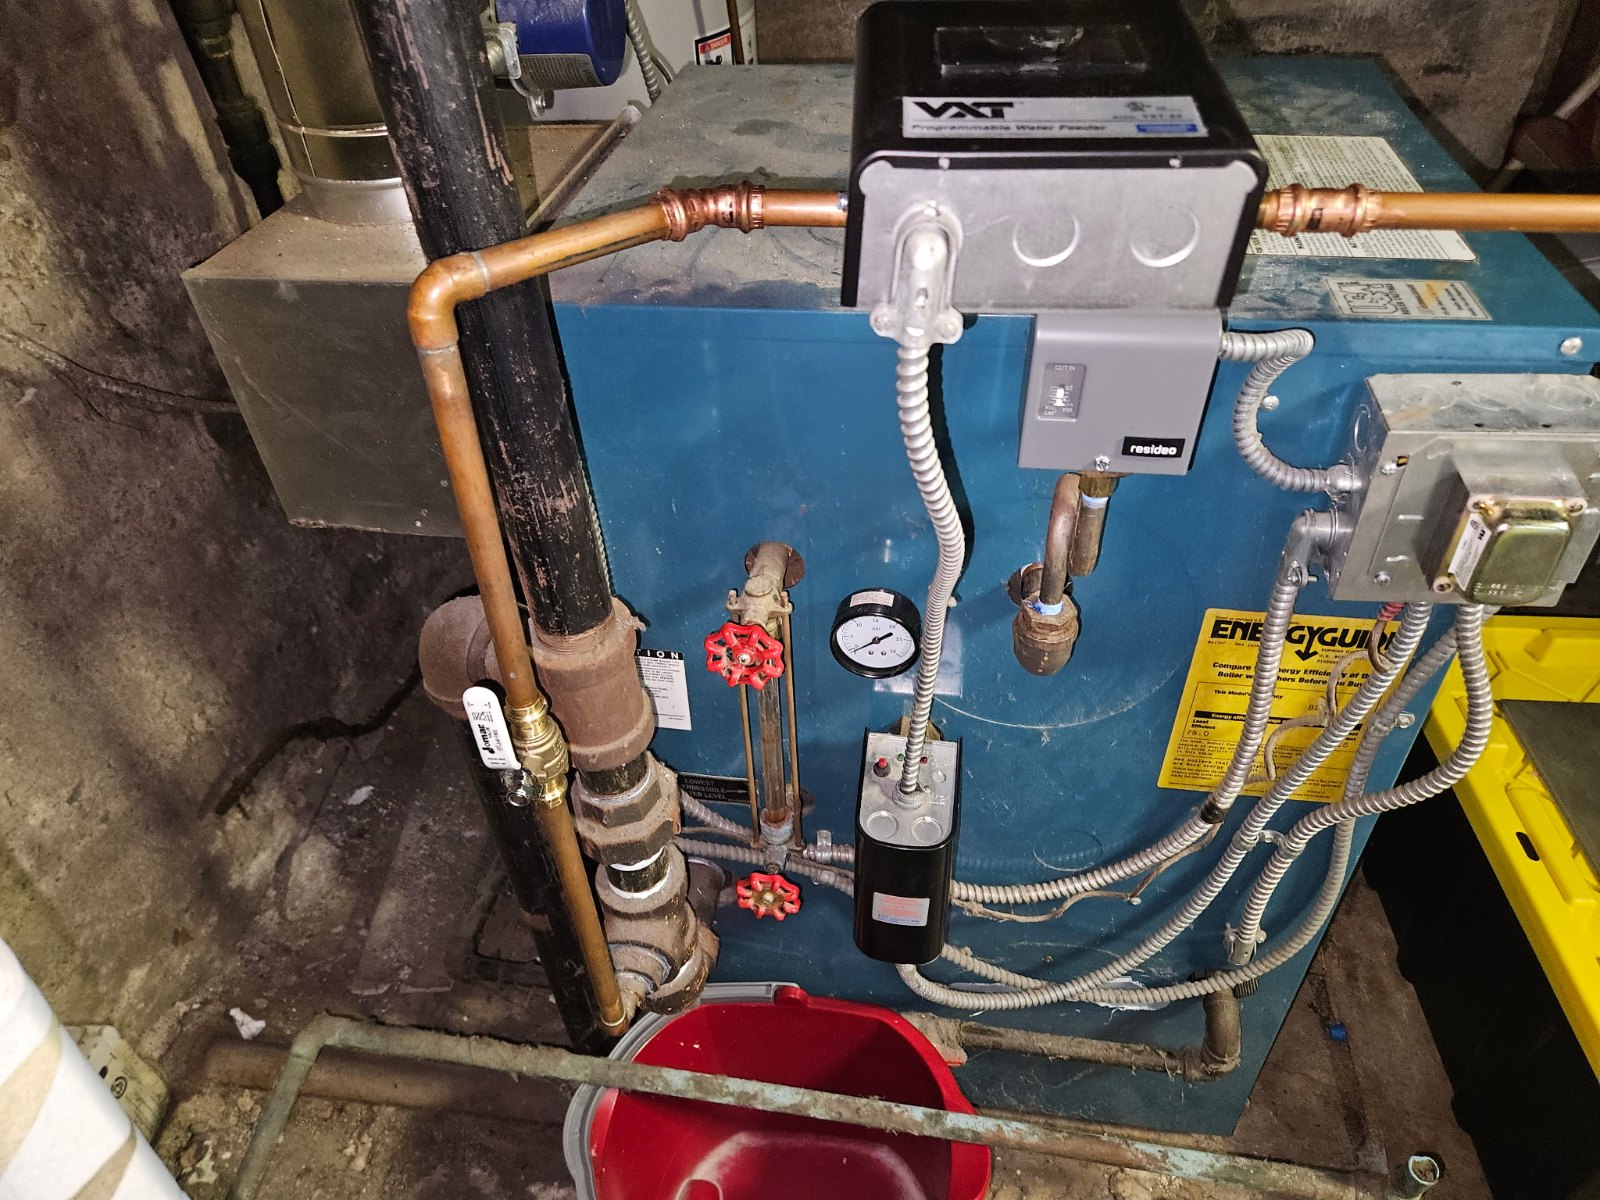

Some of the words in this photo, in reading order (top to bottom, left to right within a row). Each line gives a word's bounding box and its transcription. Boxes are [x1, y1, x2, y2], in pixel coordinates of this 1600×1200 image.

[912, 101, 1014, 119] VXT
[911, 124, 1011, 132] Programmable
[1058, 124, 1108, 132] Feeder
[1129, 443, 1178, 456] resideo
[1210, 619, 1397, 651] ENEGYGUID
[636, 648, 680, 660] TION
[1212, 661, 1252, 671] Compare
[1278, 667, 1301, 675] nergy
[1303, 668, 1348, 679] Efficiey
[1217, 671, 1244, 679] Boiler
[1276, 675, 1296, 683] hers
[1298, 677, 1328, 685] Before
[477, 723, 496, 755] Jomar
